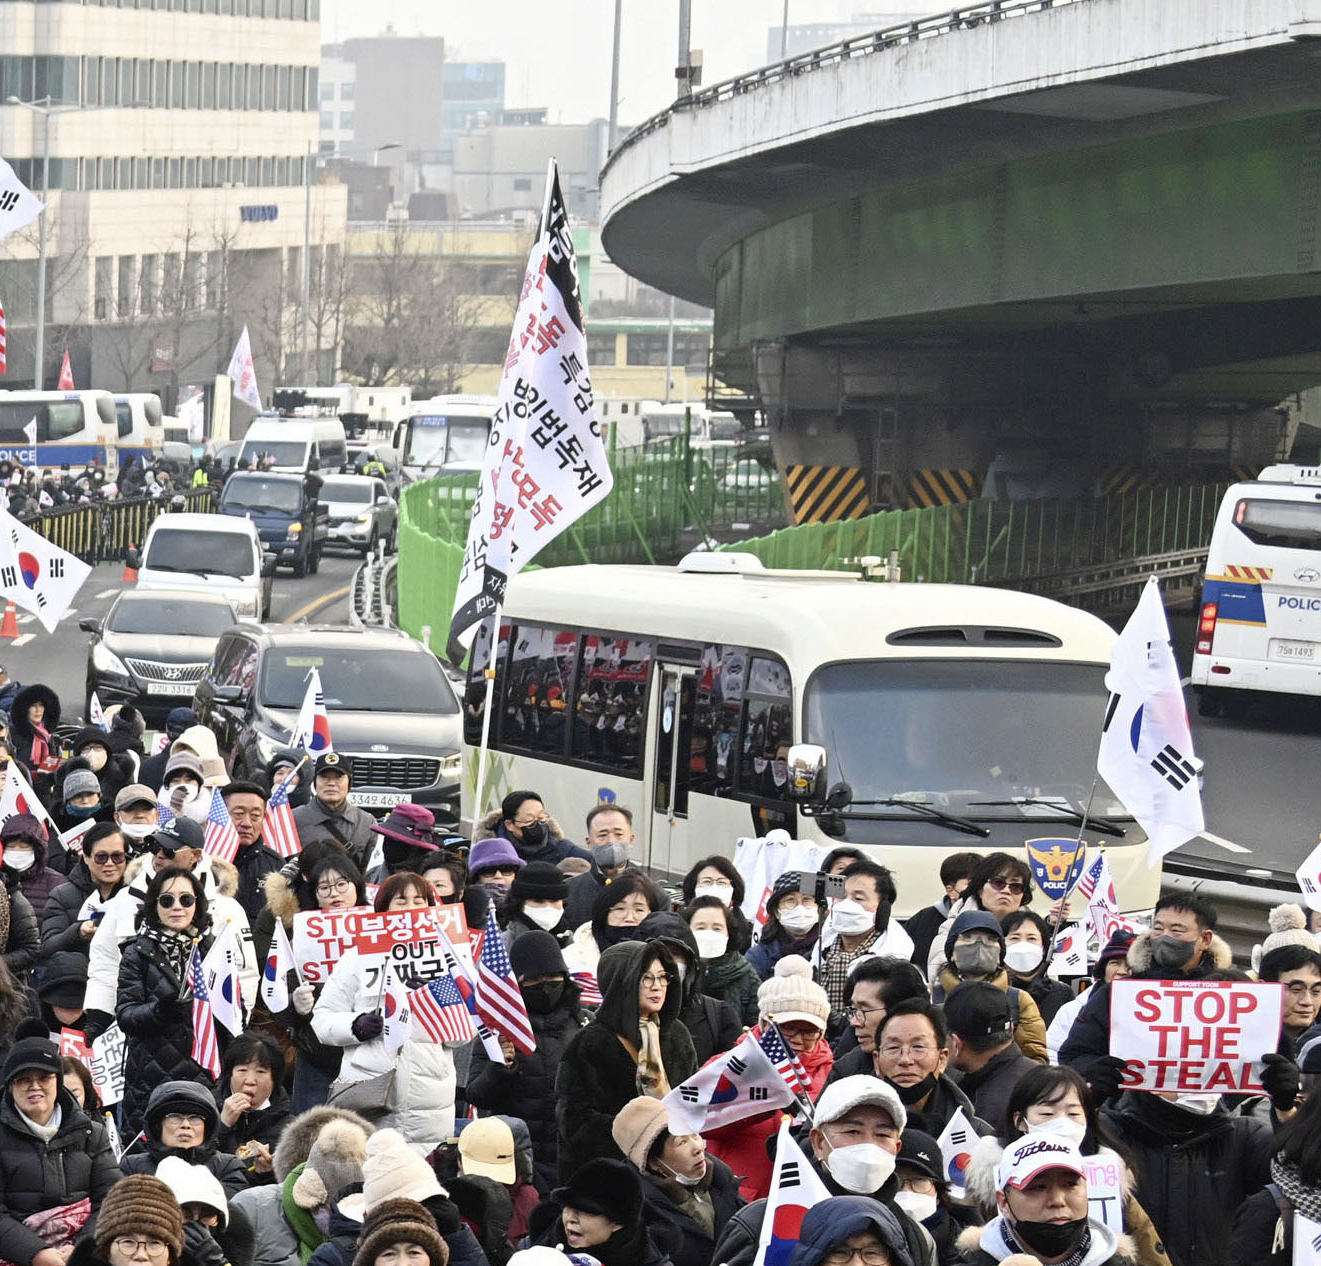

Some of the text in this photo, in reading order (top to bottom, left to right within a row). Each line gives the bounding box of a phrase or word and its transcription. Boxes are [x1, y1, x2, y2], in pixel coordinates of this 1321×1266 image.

[241, 205, 279, 222] VOLVO
[1277, 596, 1321, 611] POLIC
[1043, 881, 1068, 889] POLIC
[360, 905, 463, 944] 부정선거
[392, 939, 439, 960] OUT
[1133, 990, 1259, 1025] STOP
[1148, 1026, 1242, 1060] THE
[89, 1057, 108, 1087] OUT
[1121, 1059, 1263, 1091] STEAL
[1012, 1140, 1071, 1167] Titleist
